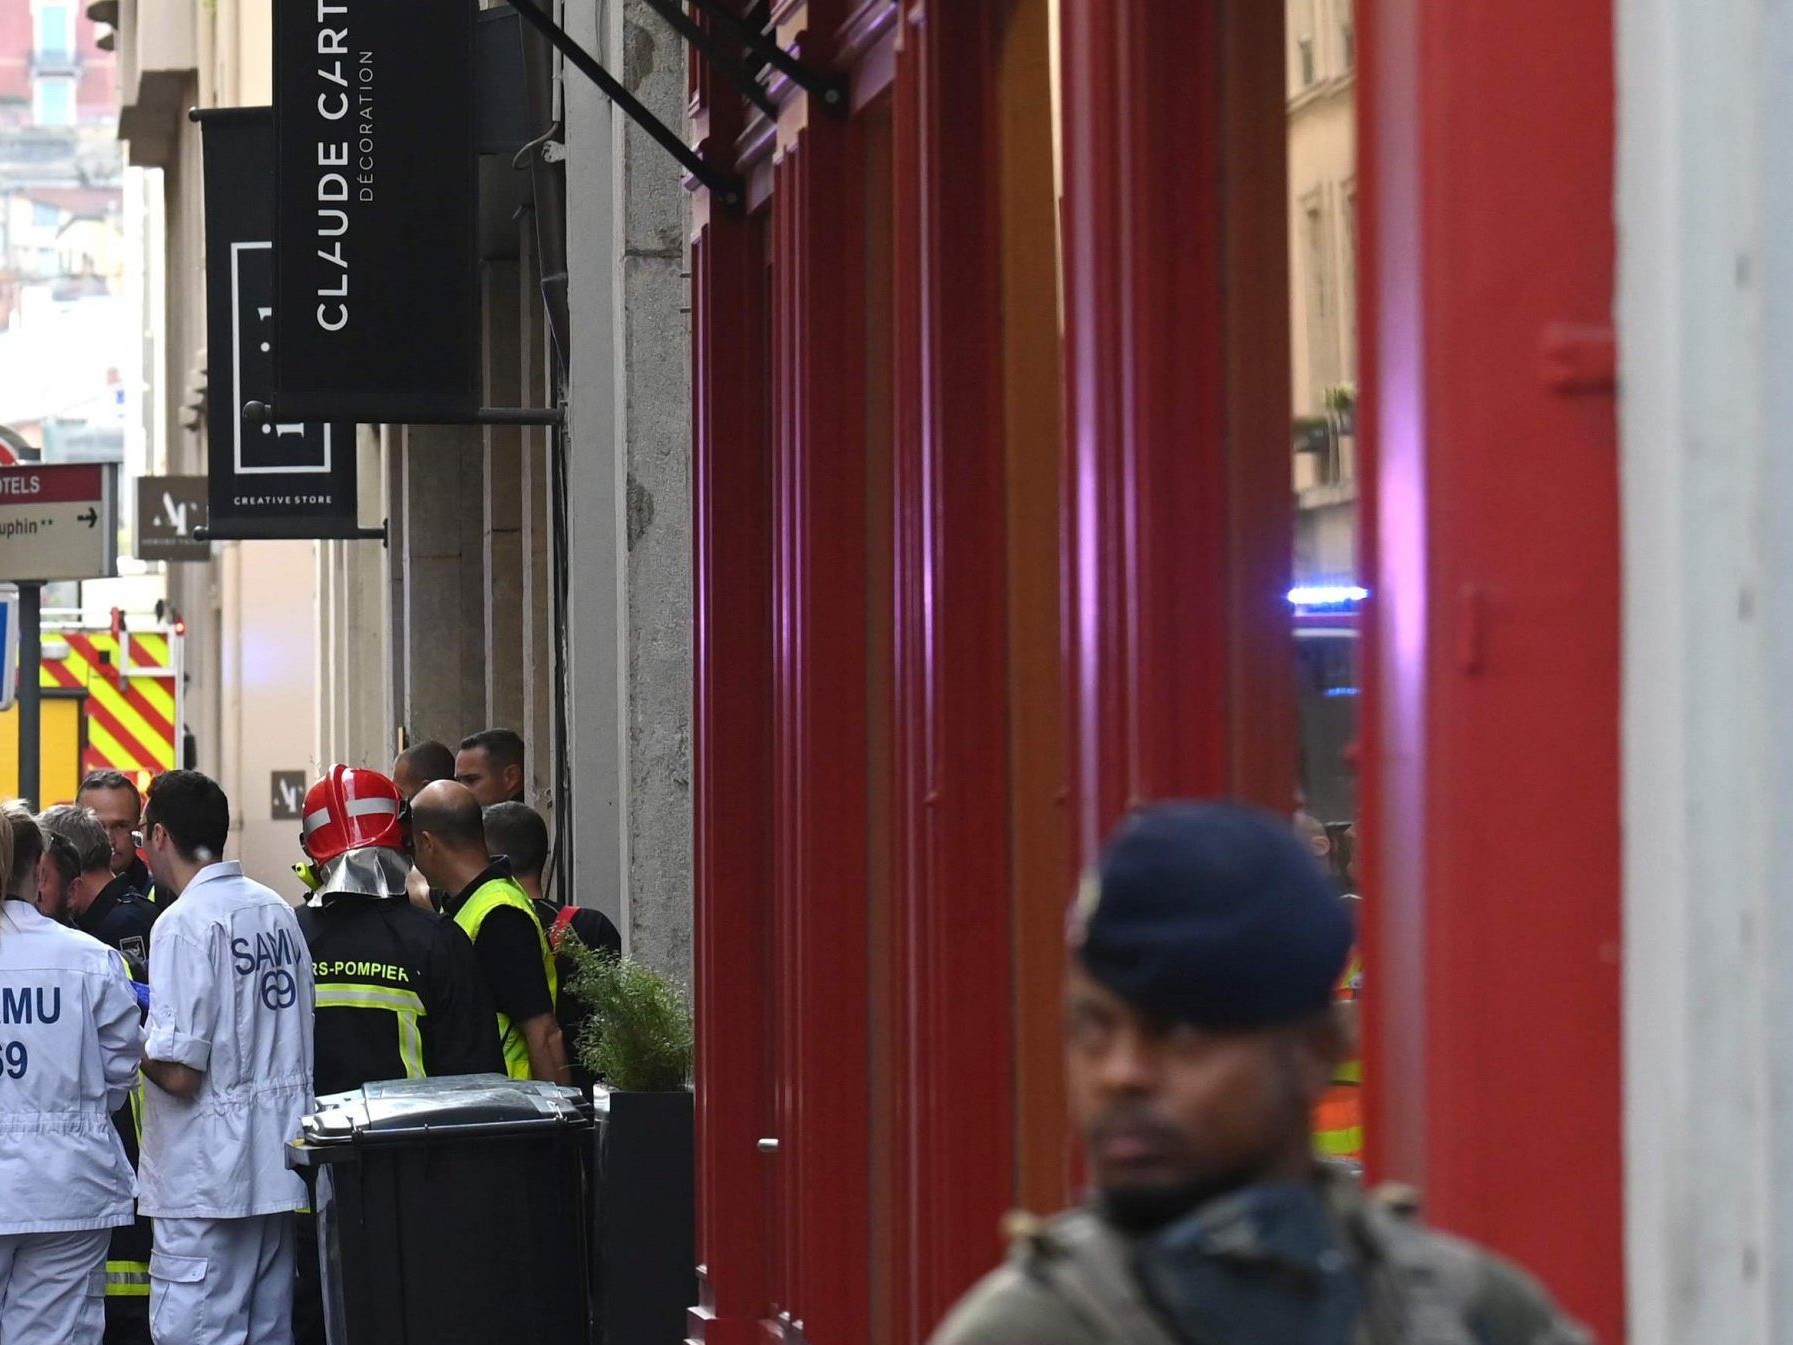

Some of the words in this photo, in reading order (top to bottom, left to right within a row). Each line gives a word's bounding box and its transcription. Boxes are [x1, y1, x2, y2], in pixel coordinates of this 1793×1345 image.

[316, 0, 349, 120] CART
[356, 50, 374, 202] DÉCORATION
[316, 141, 349, 331] CLAUDE
[233, 495, 291, 506] CREATIVE
[294, 495, 333, 505] STORE
[261, 969, 297, 1011] 69
